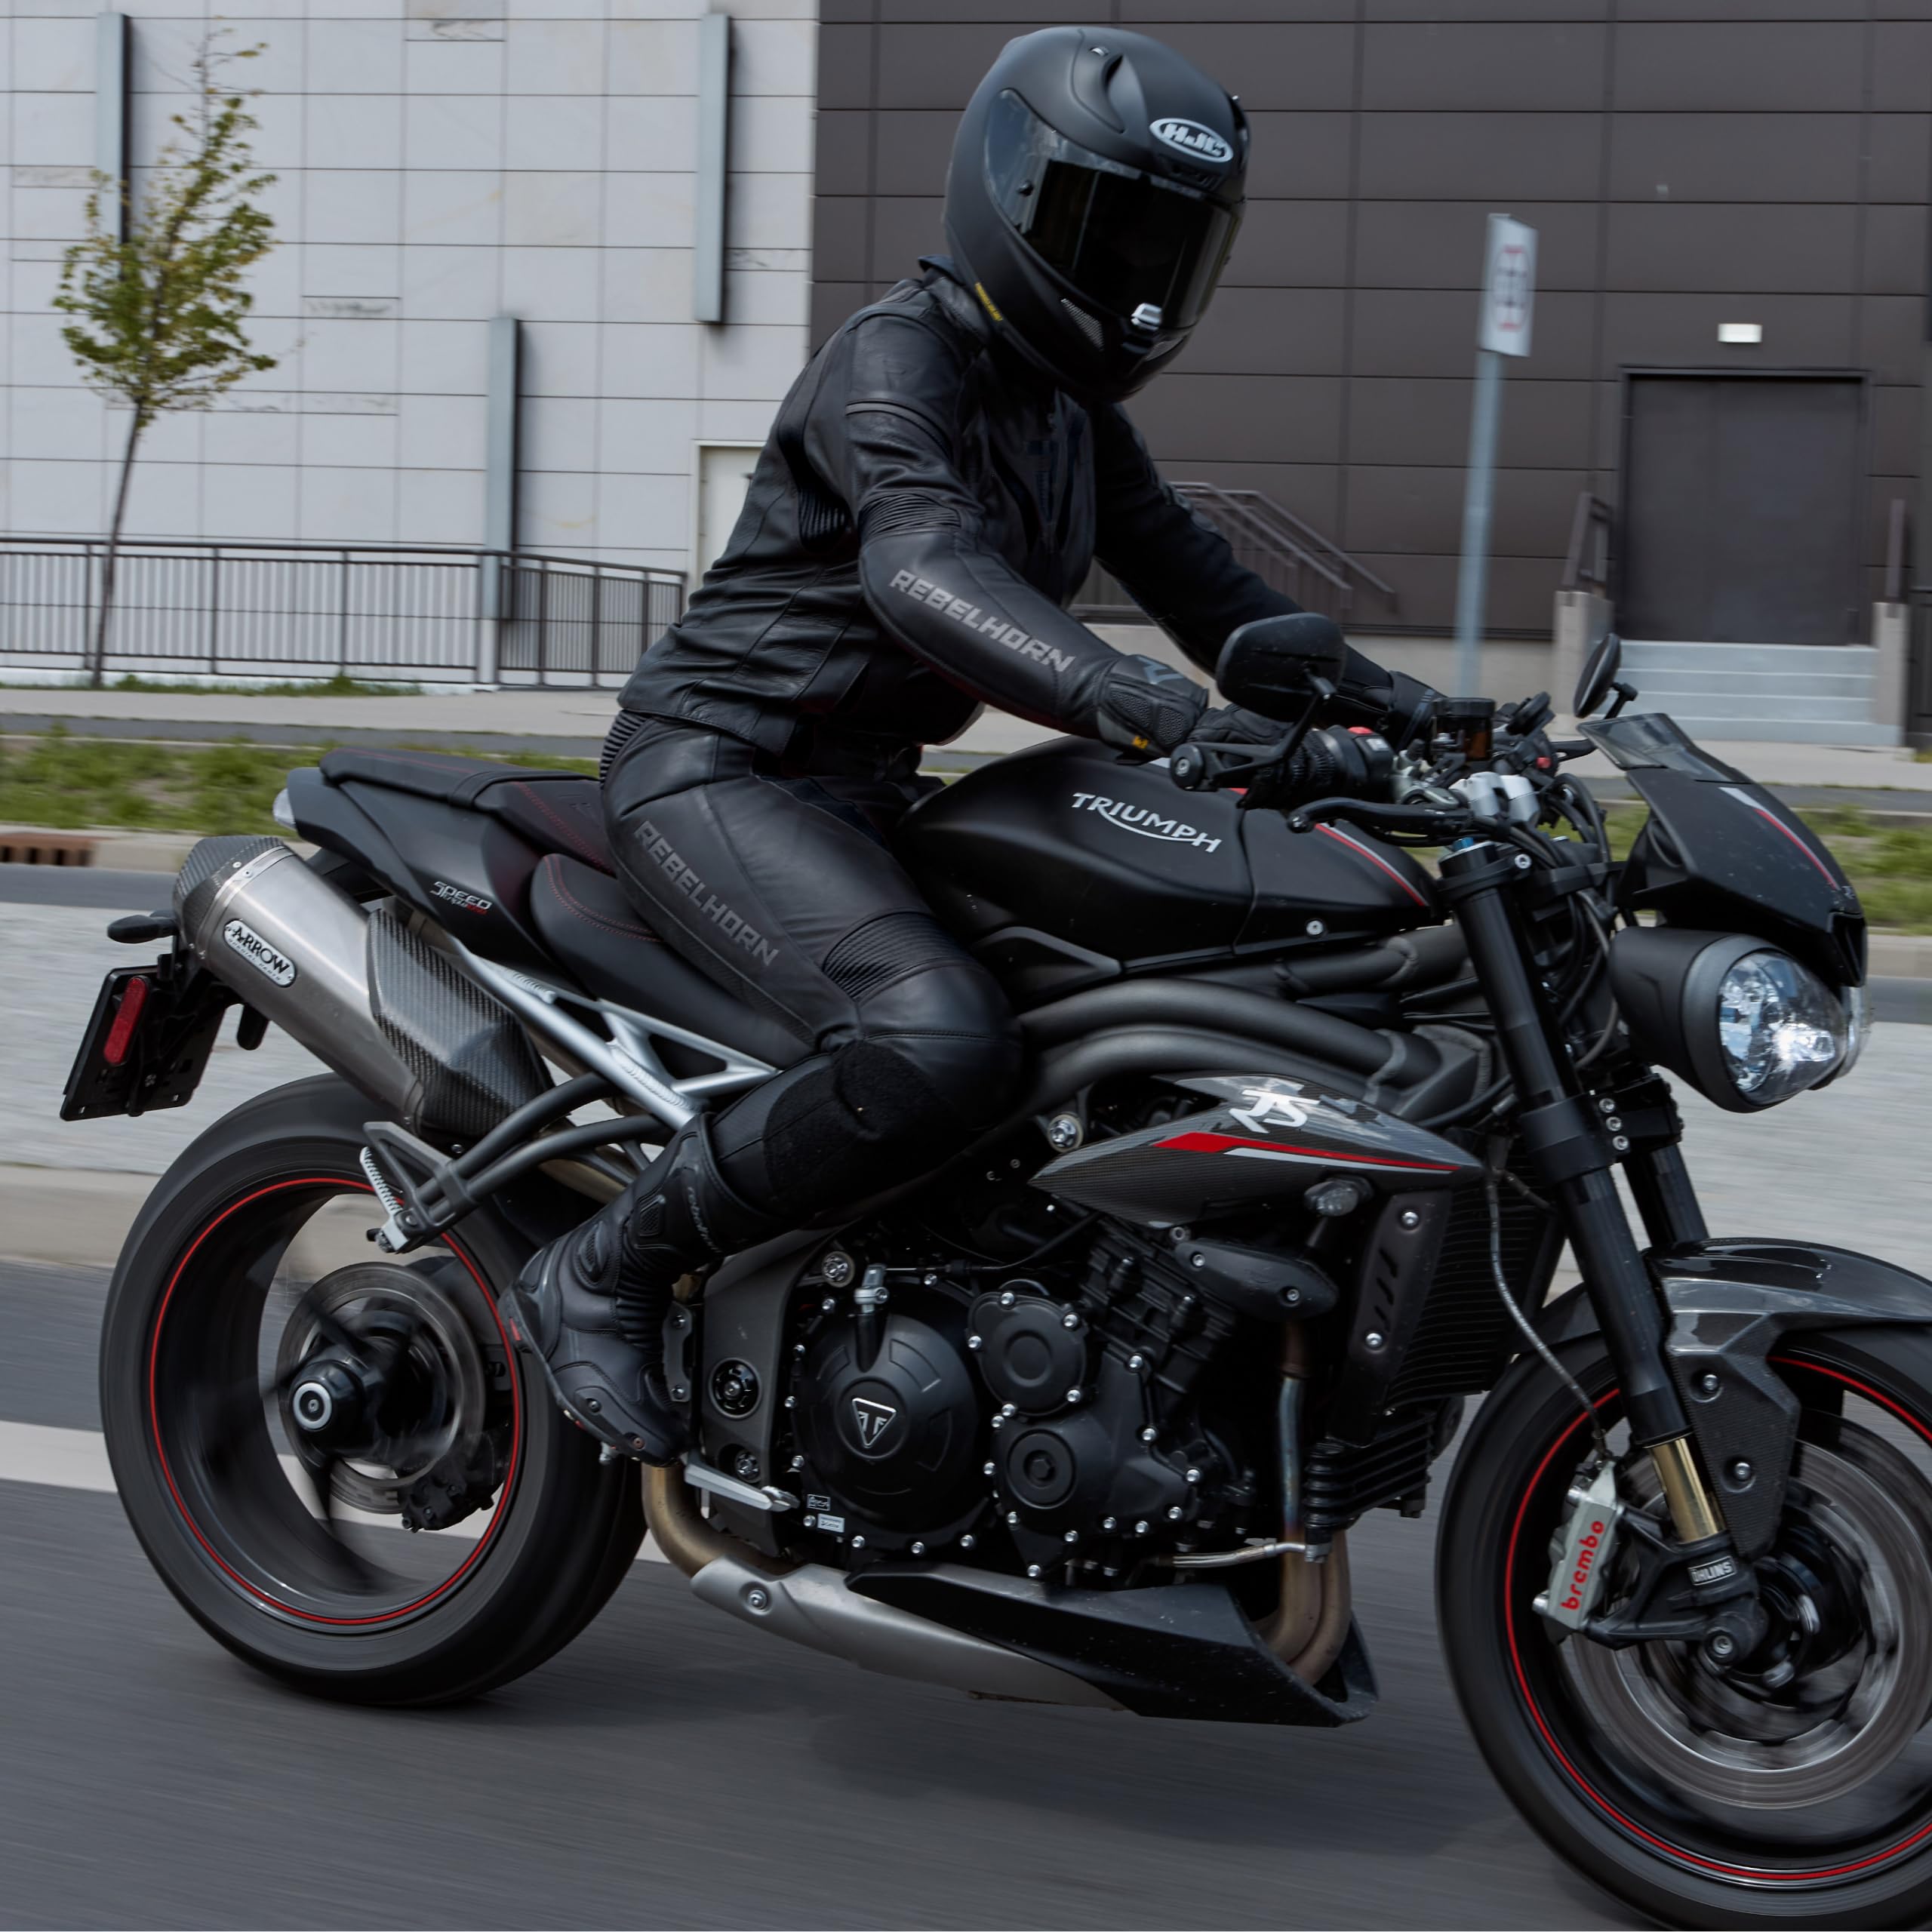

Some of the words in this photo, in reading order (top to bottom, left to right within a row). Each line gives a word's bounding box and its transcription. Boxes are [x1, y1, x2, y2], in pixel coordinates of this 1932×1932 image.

[1161, 123, 1225, 157] HJC
[888, 569, 1076, 672] REBELHORN
[1071, 792, 1223, 853] TRIUMPH
[429, 881, 493, 910] SPEED
[633, 820, 780, 967] REBELHORN
[232, 926, 291, 974] ARROW
[1228, 1089, 1321, 1134] RS
[1560, 1520, 1604, 1611] brembo
